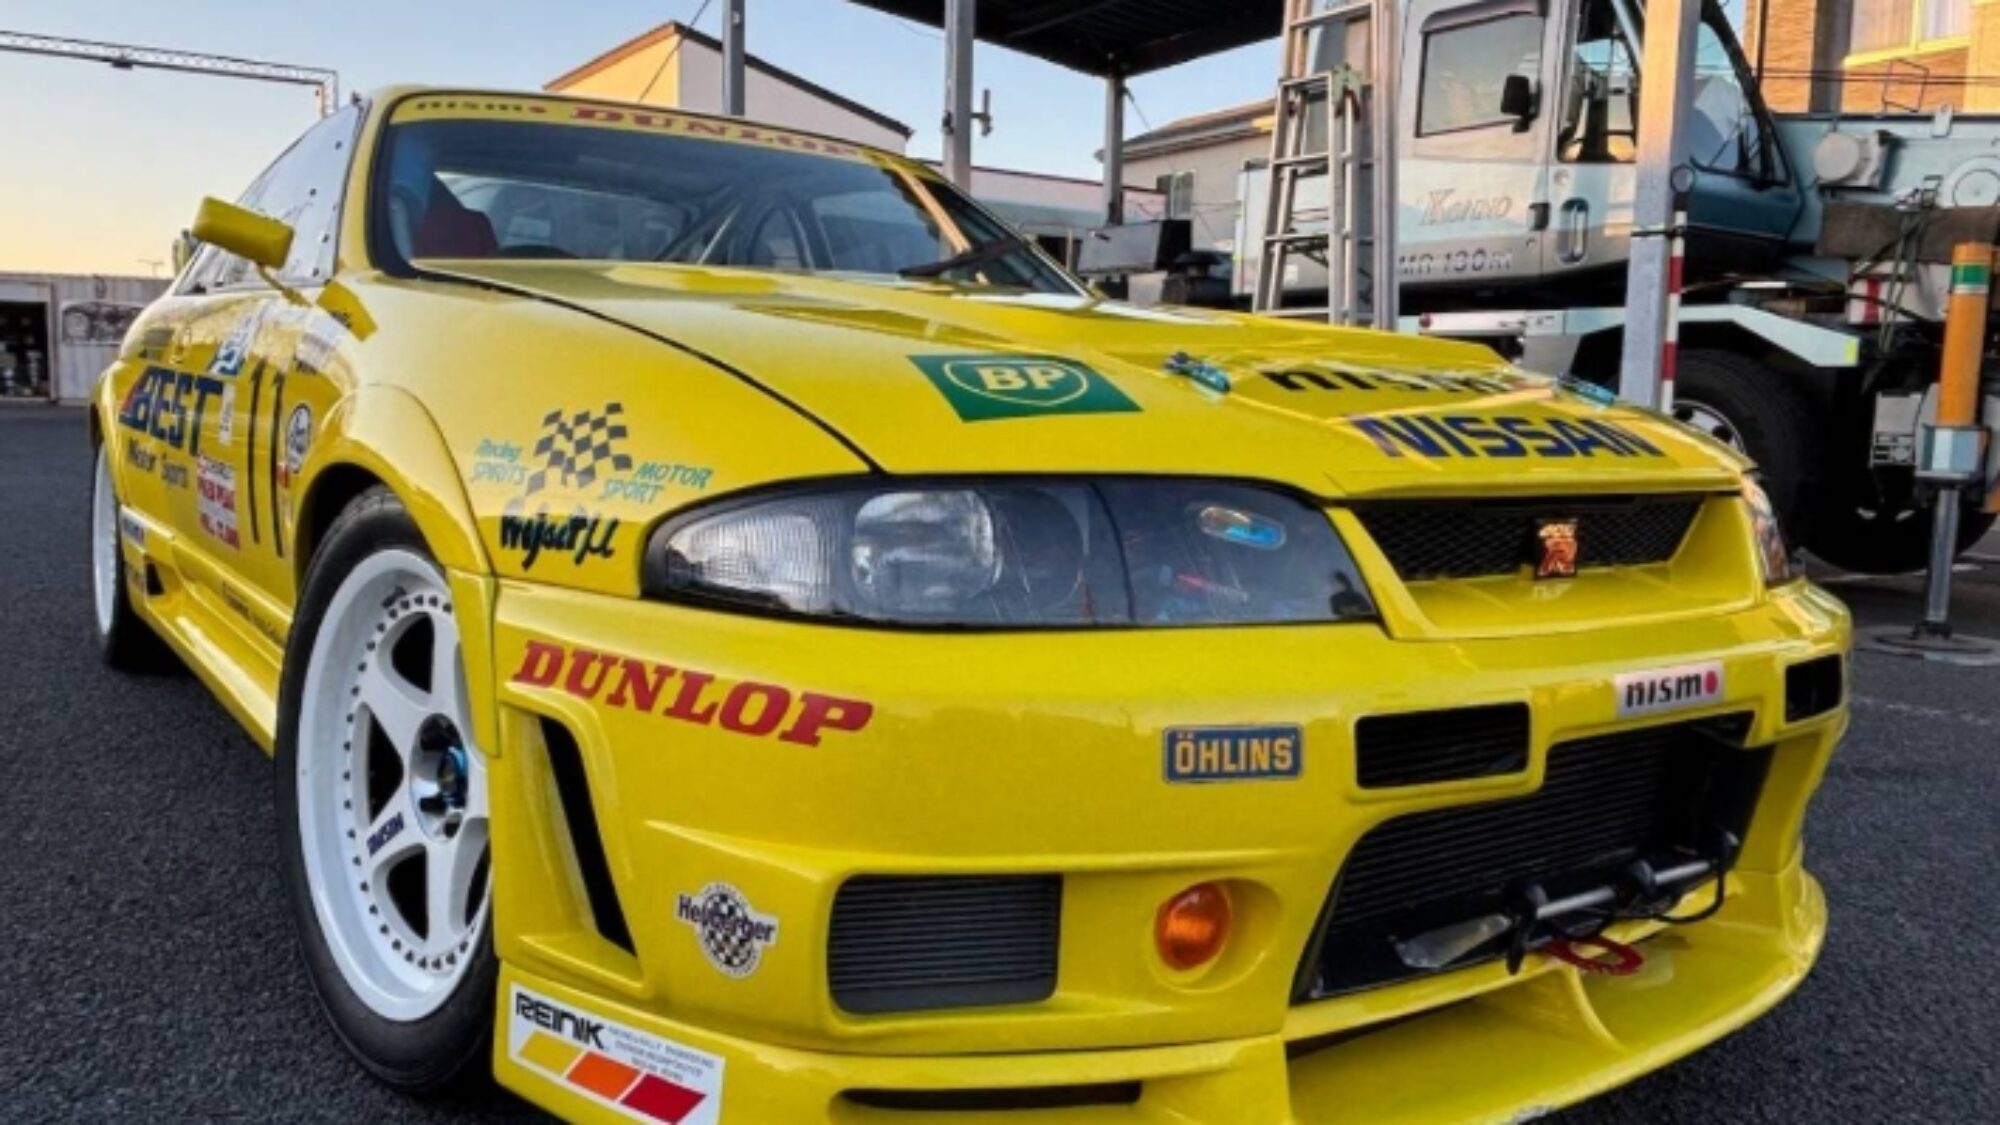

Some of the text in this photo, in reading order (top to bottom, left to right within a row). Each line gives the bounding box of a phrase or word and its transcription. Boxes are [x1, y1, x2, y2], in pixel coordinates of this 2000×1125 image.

[569, 106, 858, 157] DUNLOP
[976, 365, 1067, 390] BP
[119, 364, 224, 457] BEST
[1350, 413, 1663, 458] NISSAN
[599, 478, 663, 504] SPORT
[634, 461, 713, 489] MOTOR
[512, 639, 874, 748] DUNLOP
[1174, 730, 1294, 774] ÖHLINS
